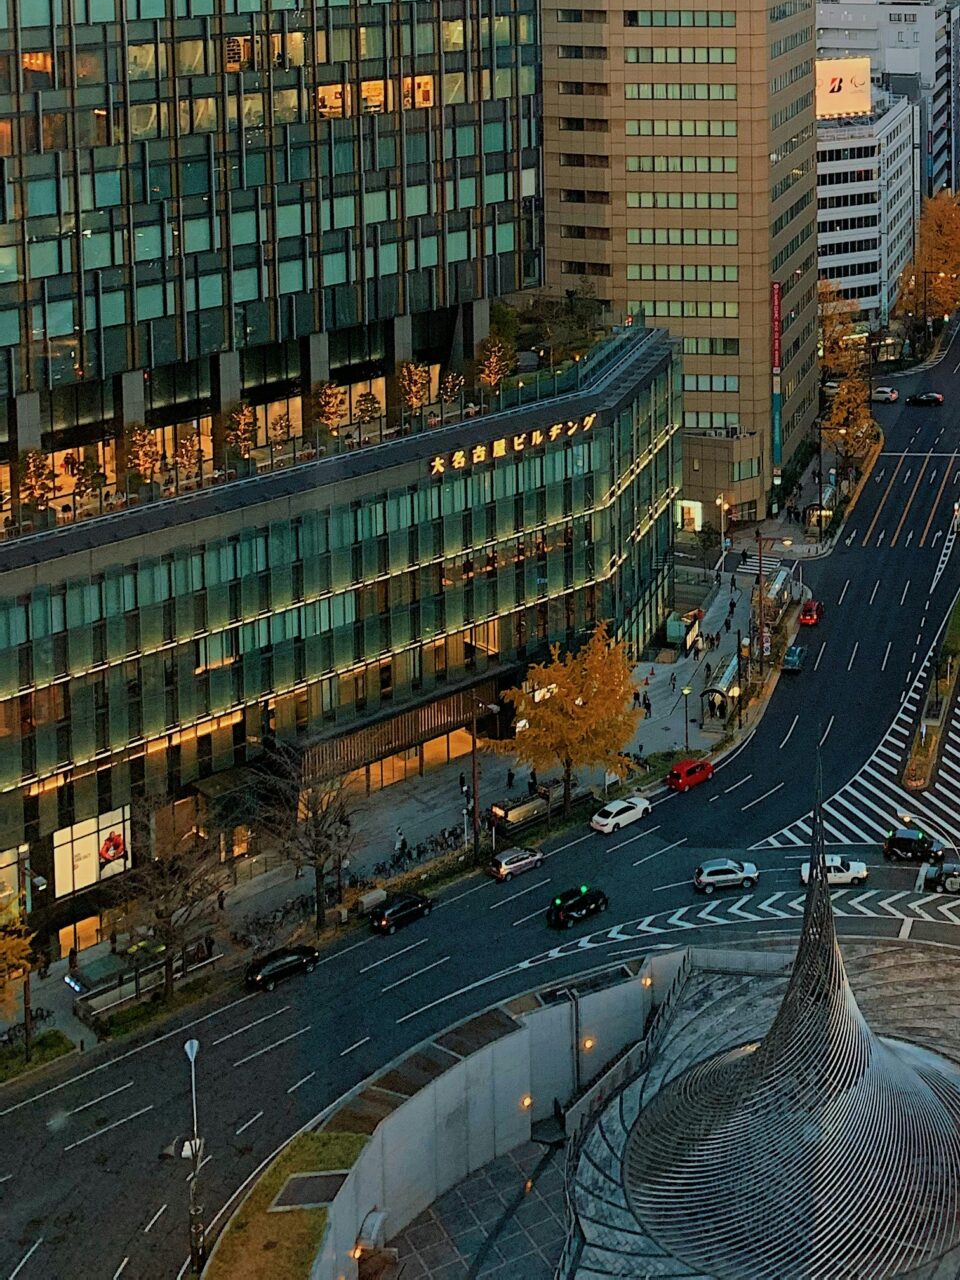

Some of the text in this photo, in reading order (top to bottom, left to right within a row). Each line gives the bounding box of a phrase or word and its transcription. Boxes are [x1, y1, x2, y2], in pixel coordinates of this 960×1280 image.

[430, 412, 597, 476] 大名古屋ビルヂング
